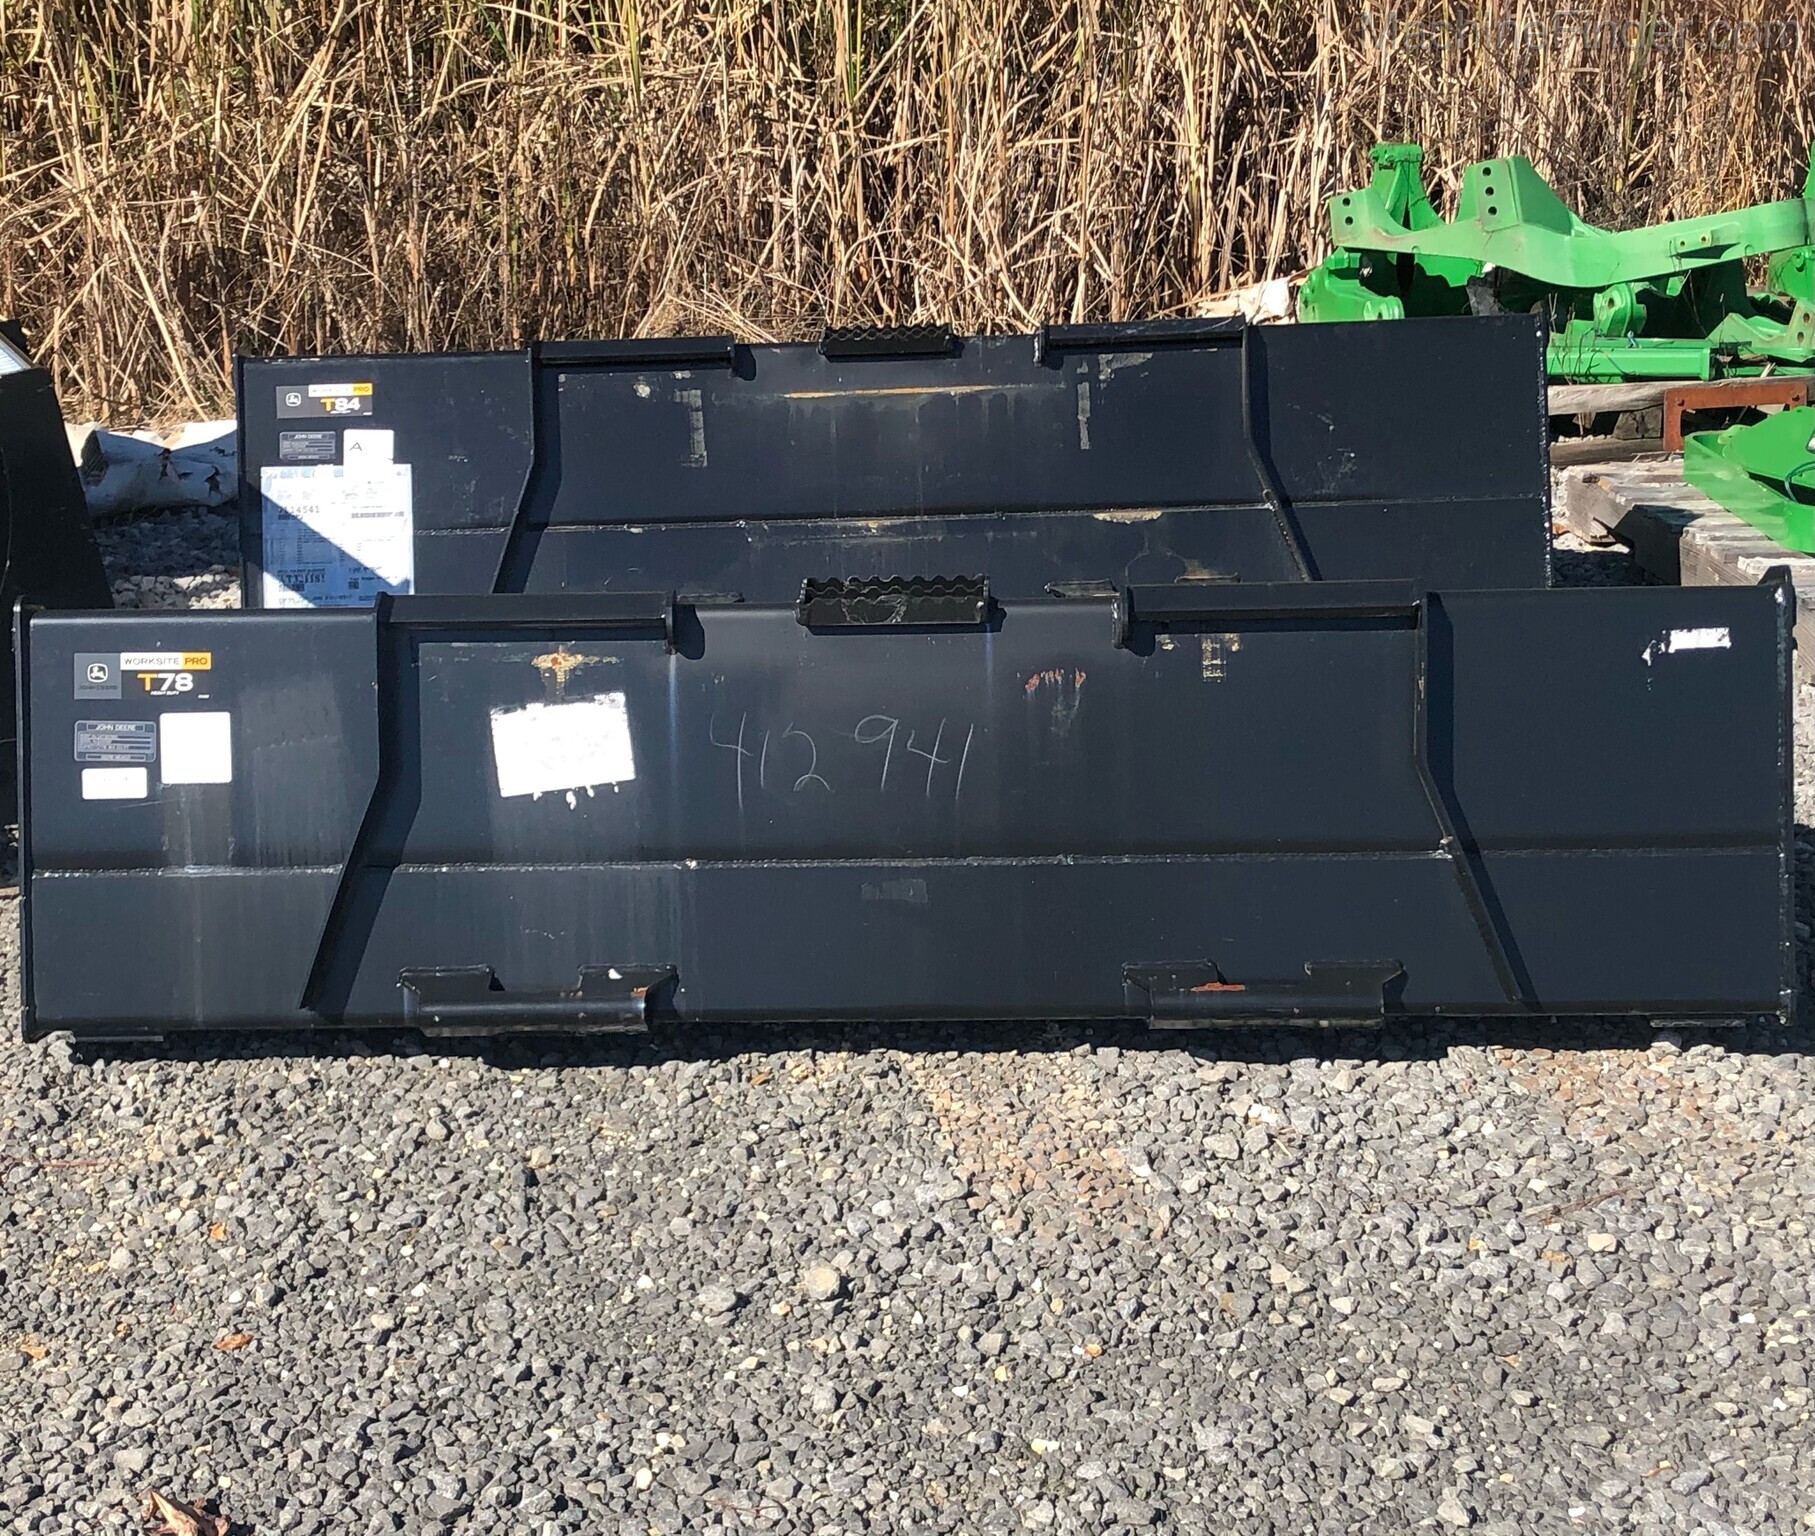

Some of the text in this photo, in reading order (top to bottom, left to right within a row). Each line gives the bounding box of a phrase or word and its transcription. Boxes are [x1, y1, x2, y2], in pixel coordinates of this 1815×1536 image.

[320, 396, 361, 412] T84
[349, 442, 363, 451] A
[124, 657, 208, 666] WORKSITE PRO
[136, 672, 194, 692] T78
[95, 723, 137, 732] JOHN DEERE
[709, 711, 975, 811] 412 941
